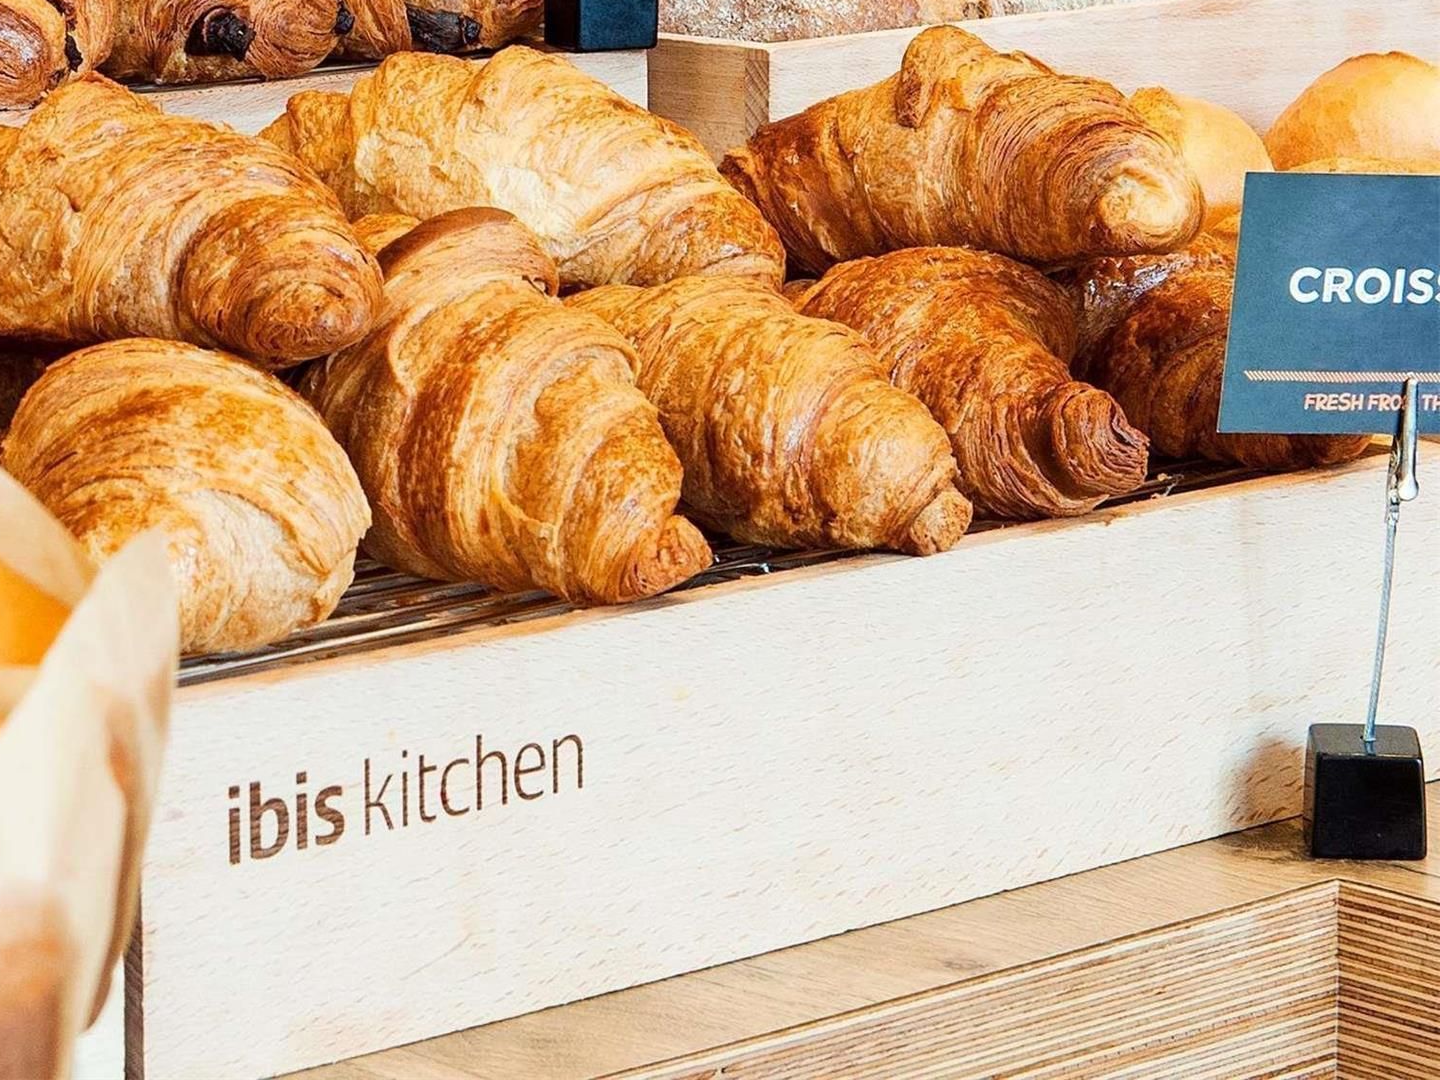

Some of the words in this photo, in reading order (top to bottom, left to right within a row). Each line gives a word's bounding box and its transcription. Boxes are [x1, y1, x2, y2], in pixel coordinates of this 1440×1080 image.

[1289, 267, 1440, 304] CROIS
[1304, 393, 1364, 412] FRESH
[1367, 393, 1409, 412] FRO
[228, 771, 346, 866] ibis
[364, 733, 584, 836] kitchen
